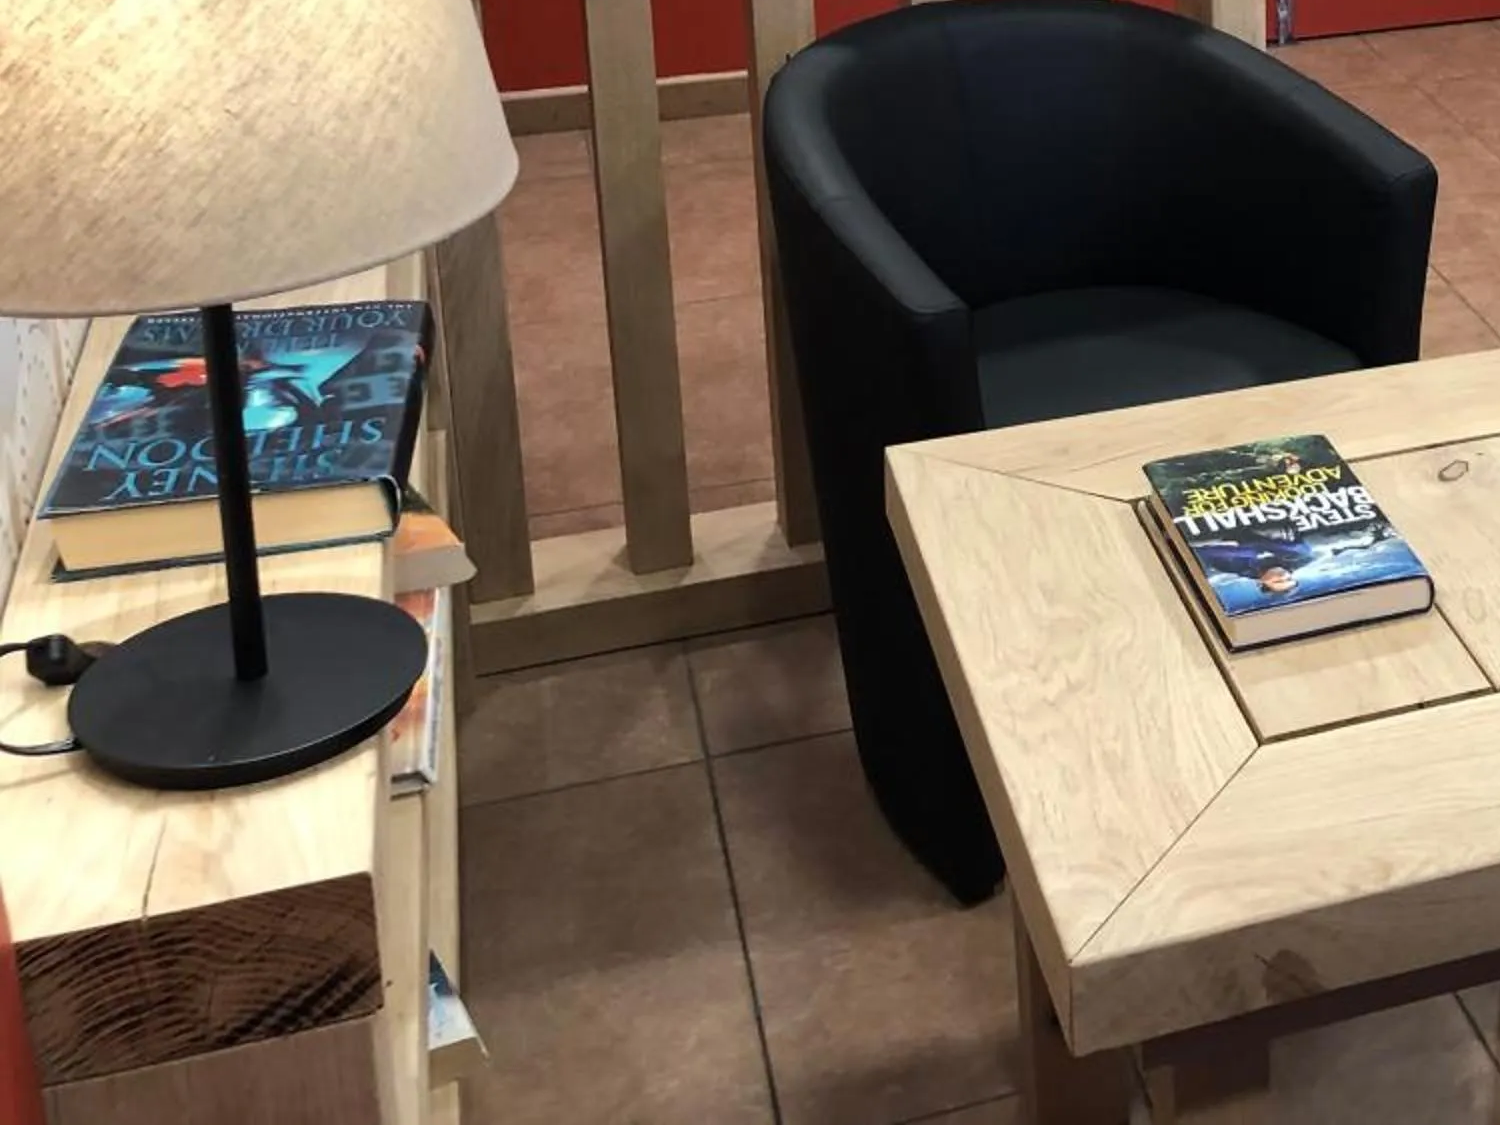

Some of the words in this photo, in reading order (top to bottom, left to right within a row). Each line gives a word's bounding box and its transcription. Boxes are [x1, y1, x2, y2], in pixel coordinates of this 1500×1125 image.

[143, 319, 293, 345] DRMS
[302, 310, 407, 335] YOUR
[100, 451, 336, 500] SINEY
[1182, 465, 1342, 502] ADVENTURE
[1173, 485, 1374, 535] BACKSHALL
[1182, 496, 1229, 518] FOR
[1231, 481, 1328, 510] LOOKING
[1295, 503, 1376, 532] STEVE
